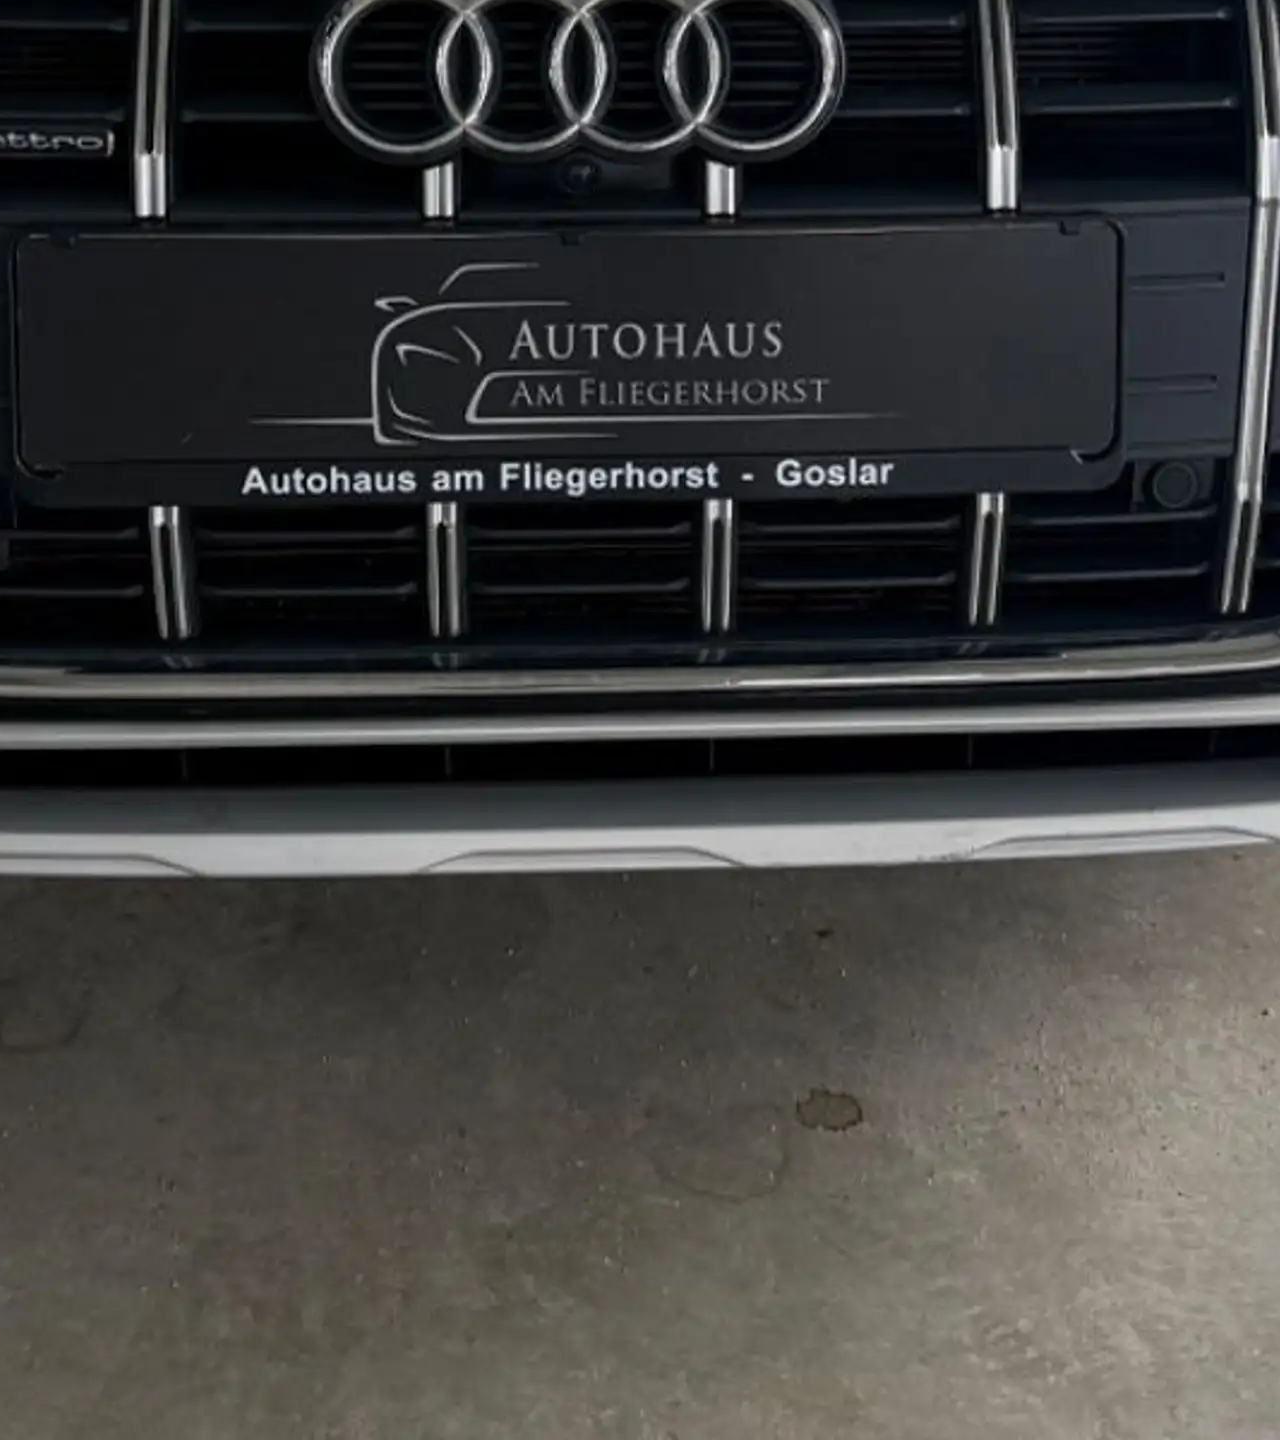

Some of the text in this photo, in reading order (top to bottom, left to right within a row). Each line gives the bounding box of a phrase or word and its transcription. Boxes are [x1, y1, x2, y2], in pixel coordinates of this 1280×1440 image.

[509, 320, 784, 361] AUTOHAUS
[510, 376, 831, 408] AM FLIEGERHORST
[240, 464, 418, 495] Autohaus
[431, 468, 485, 493] am
[499, 460, 720, 498] Fliegerhorst
[775, 457, 895, 487] Goslar
